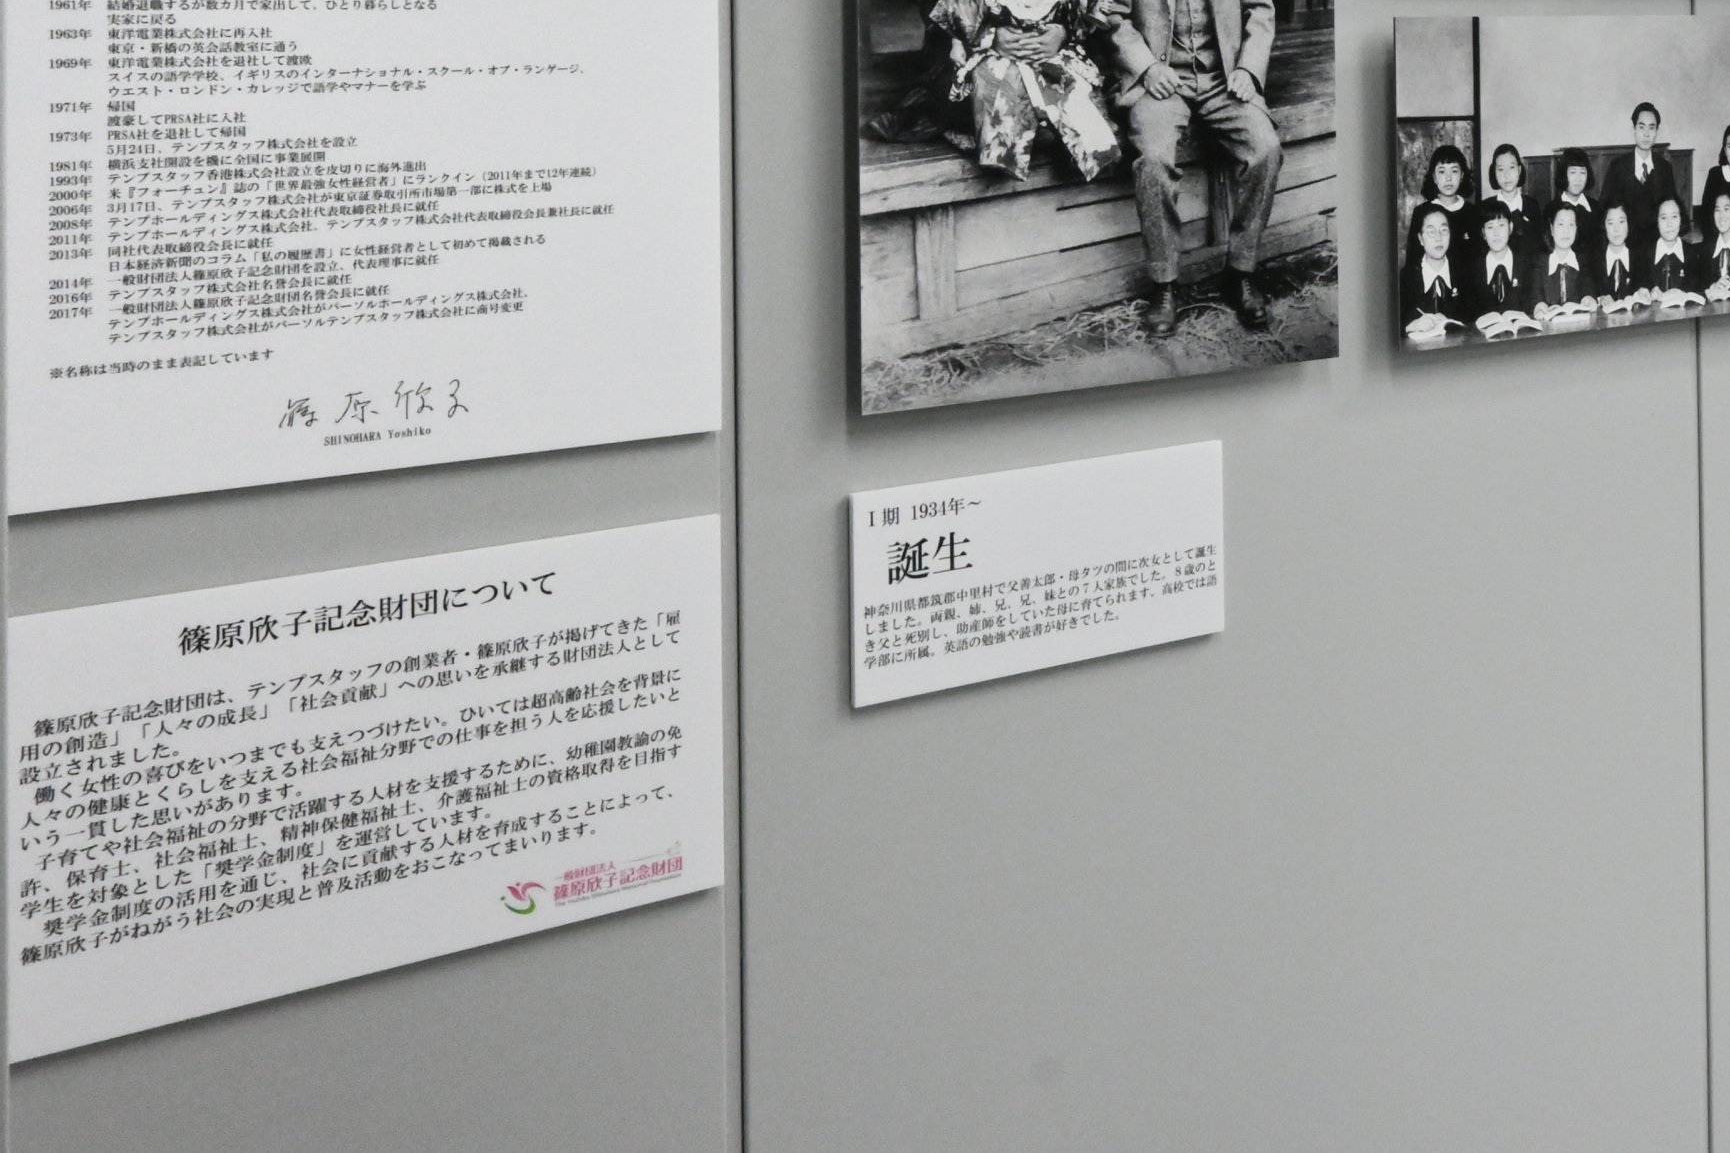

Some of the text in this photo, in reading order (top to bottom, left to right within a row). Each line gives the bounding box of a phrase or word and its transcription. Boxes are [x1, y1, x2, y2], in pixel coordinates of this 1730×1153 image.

[49, 28, 93, 41] 1963年
[49, 57, 93, 70] 1969年
[49, 101, 93, 114] 1971年
[49, 130, 93, 143] 1973年
[49, 159, 93, 173] 1981年
[49, 174, 93, 188] 1993年
[48, 188, 93, 203] 2000年
[48, 203, 93, 217] 2006年
[48, 218, 93, 232] 2008年
[48, 232, 93, 246] 2011年
[48, 247, 93, 261] 2013年
[48, 276, 94, 291] 2014年
[48, 291, 93, 306] 2016年
[48, 306, 94, 320] 2017年
[323, 425, 432, 447] SHINOHARA Yoshiko
[885, 530, 974, 586] 誕生
[177, 571, 557, 657] 篠原欣子記念財団について
[18, 742, 180, 786] 設立されました。
[20, 782, 302, 852] いう一貫した思いがあります。
[553, 856, 683, 901] 篠原欣子記念財団
